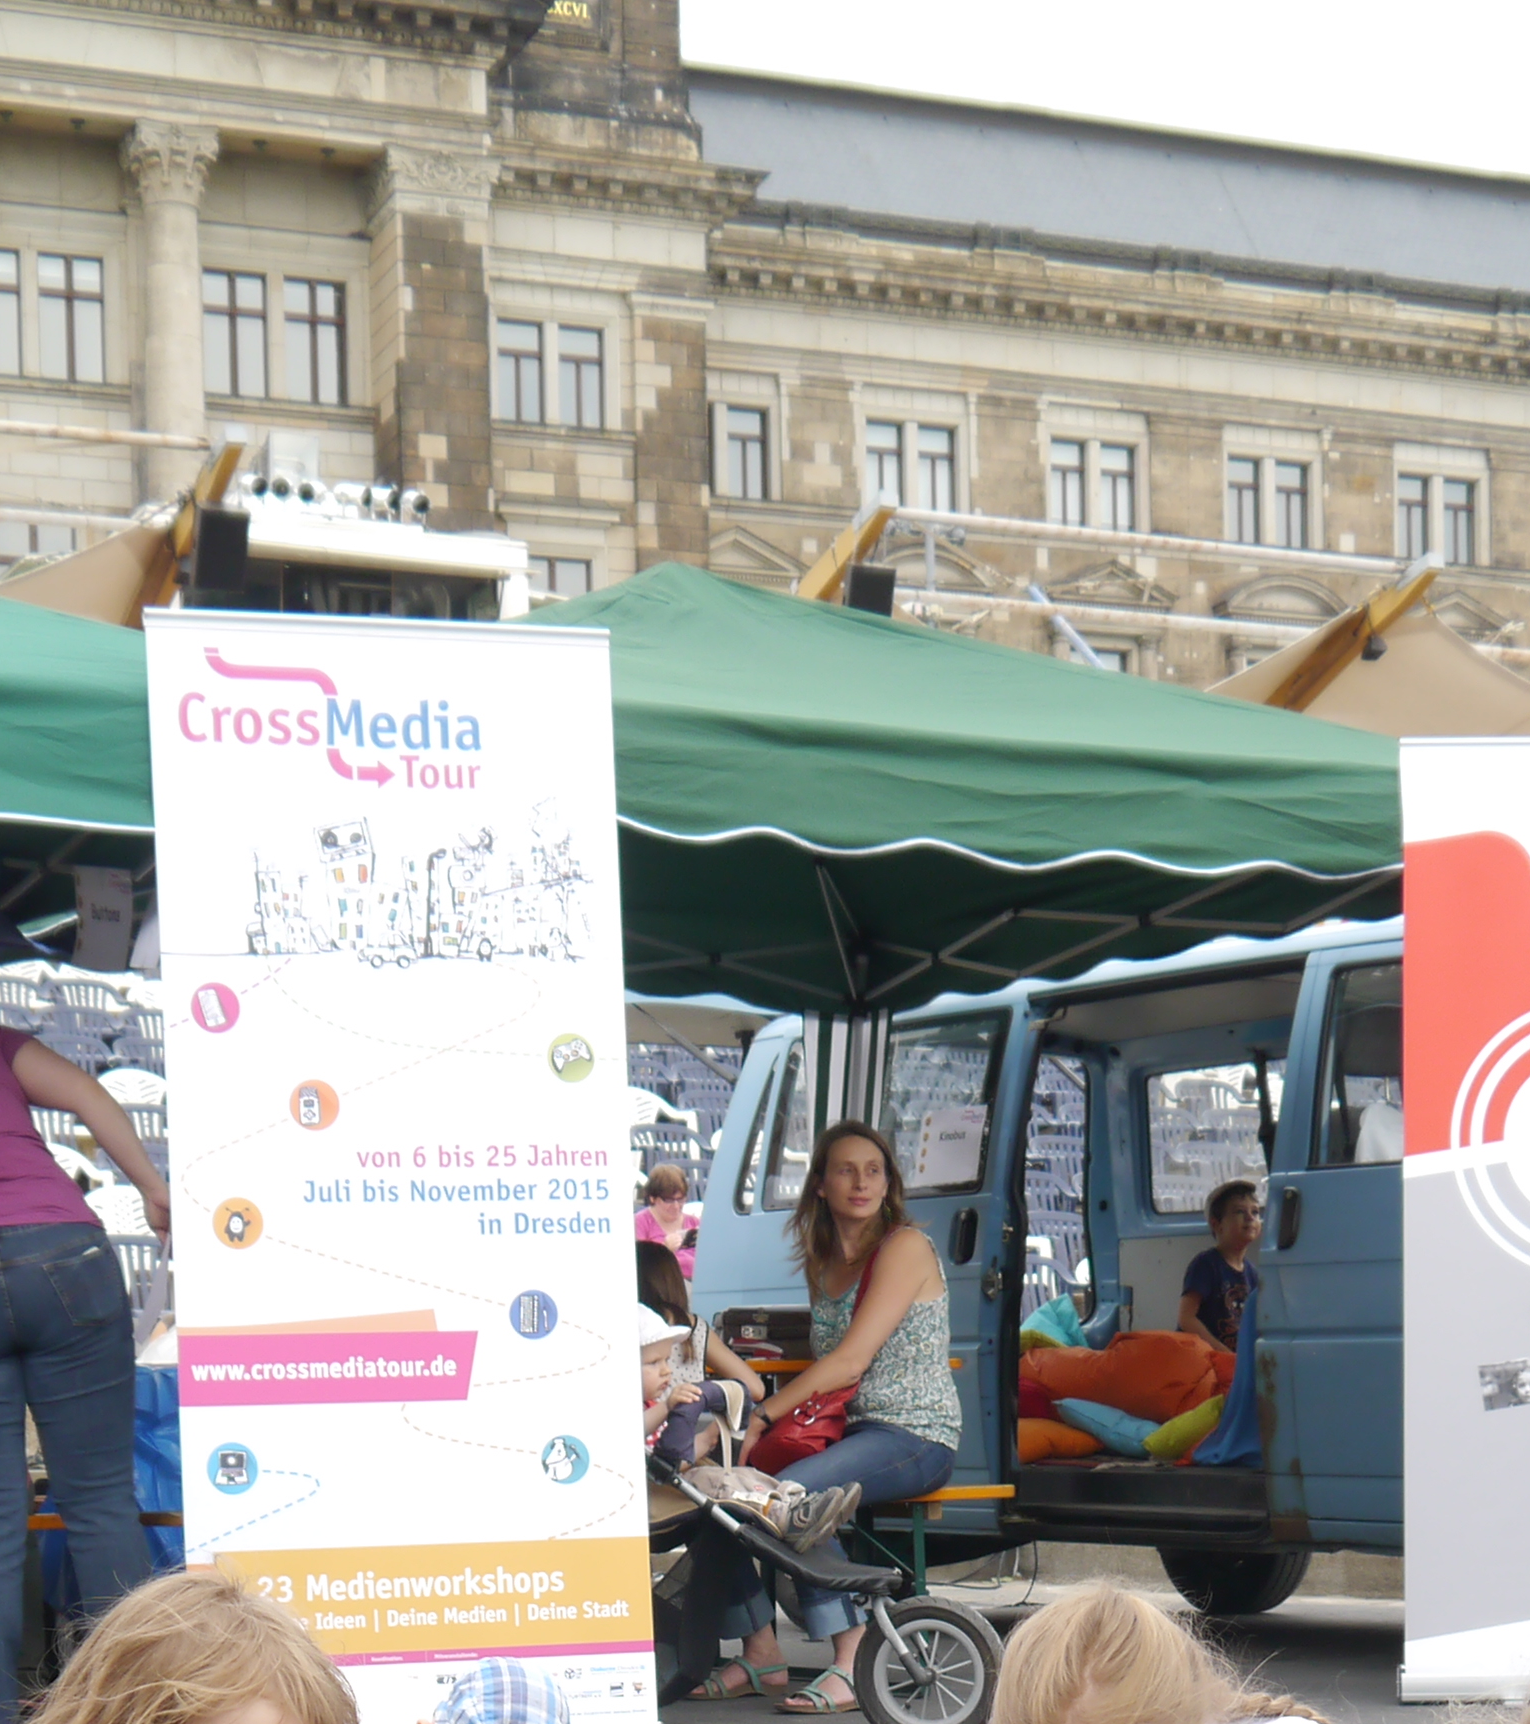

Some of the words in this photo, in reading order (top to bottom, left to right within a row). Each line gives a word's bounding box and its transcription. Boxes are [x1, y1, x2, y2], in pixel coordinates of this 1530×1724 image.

[178, 692, 482, 752] CrossMedia
[399, 755, 482, 790] Tour
[357, 1150, 401, 1168] von
[413, 1146, 427, 1168] 6
[438, 1144, 475, 1168] bis
[486, 1145, 518, 1167] 25
[527, 1144, 608, 1167] Jahren
[303, 1179, 351, 1203] Juli
[363, 1179, 399, 1202] bis
[410, 1178, 538, 1202] November
[548, 1178, 610, 1200] 2015
[478, 1212, 503, 1235] in
[514, 1211, 611, 1234] Dresden
[191, 1356, 457, 1382] www.crossmediatour.de
[257, 1576, 293, 1603] 23
[306, 1566, 565, 1602] Medienworkshops
[315, 1612, 367, 1631] Ideen
[386, 1608, 438, 1627] Deine
[444, 1605, 508, 1624] Medien
[527, 1602, 578, 1622] Deine
[582, 1600, 630, 1619] Stadt
